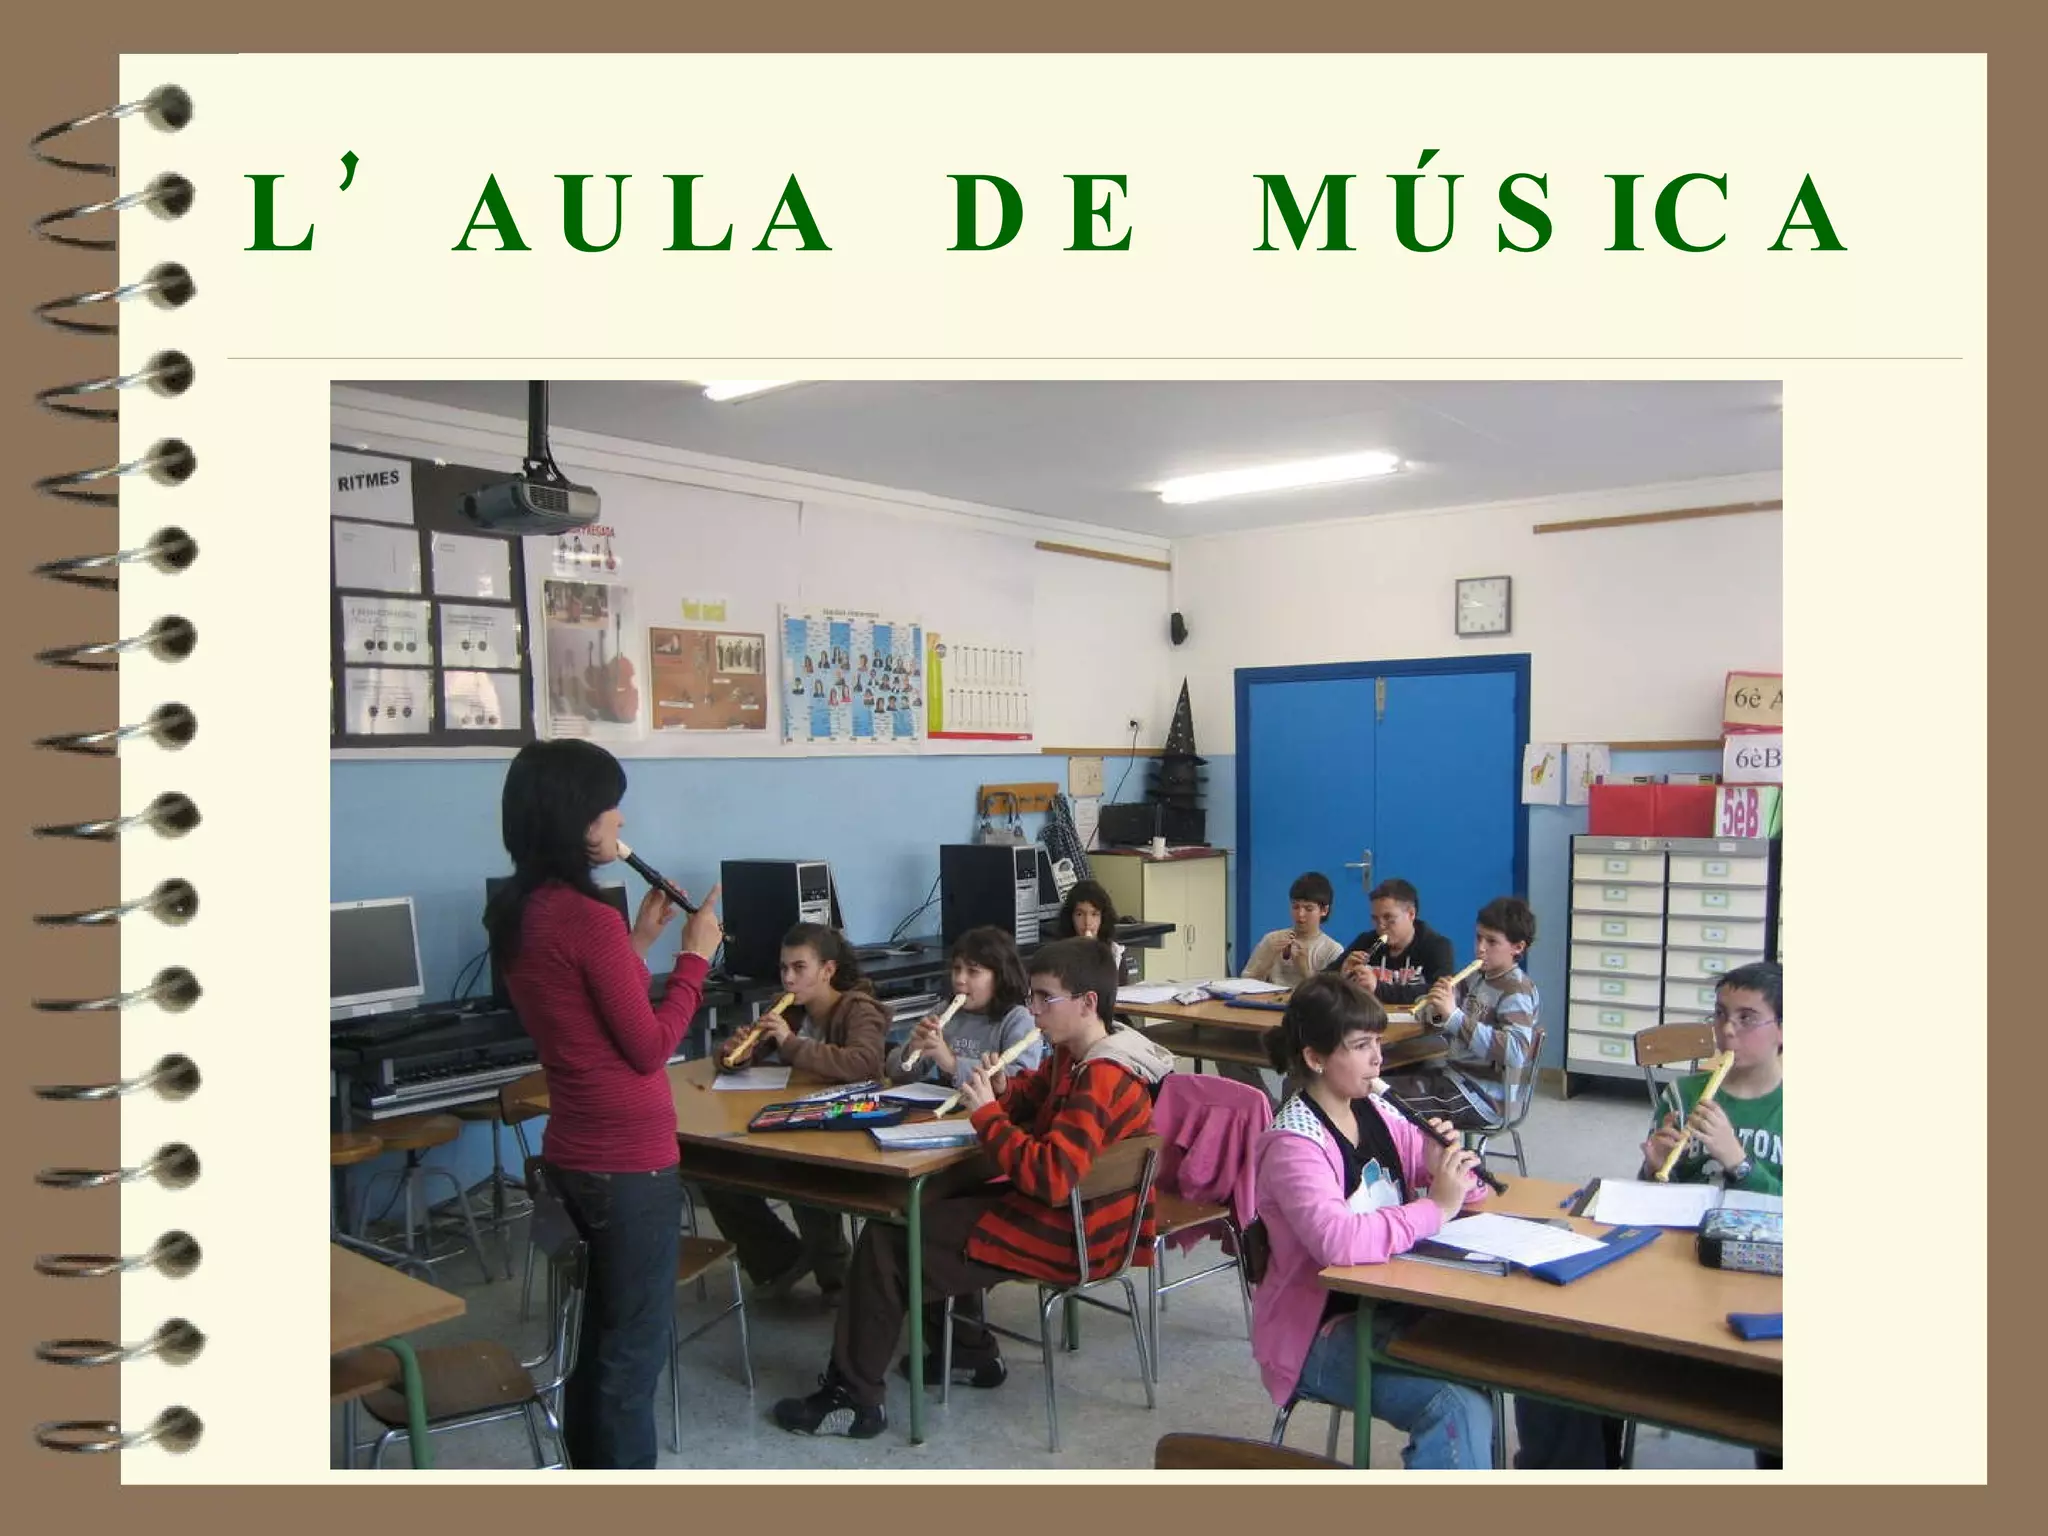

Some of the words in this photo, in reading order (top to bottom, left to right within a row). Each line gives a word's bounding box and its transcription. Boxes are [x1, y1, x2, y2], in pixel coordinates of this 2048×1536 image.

[338, 470, 400, 492] RITMES
[1735, 687, 1761, 709] 6è
[1735, 747, 1782, 769] 6èB
[1722, 788, 1760, 839] 5èB
